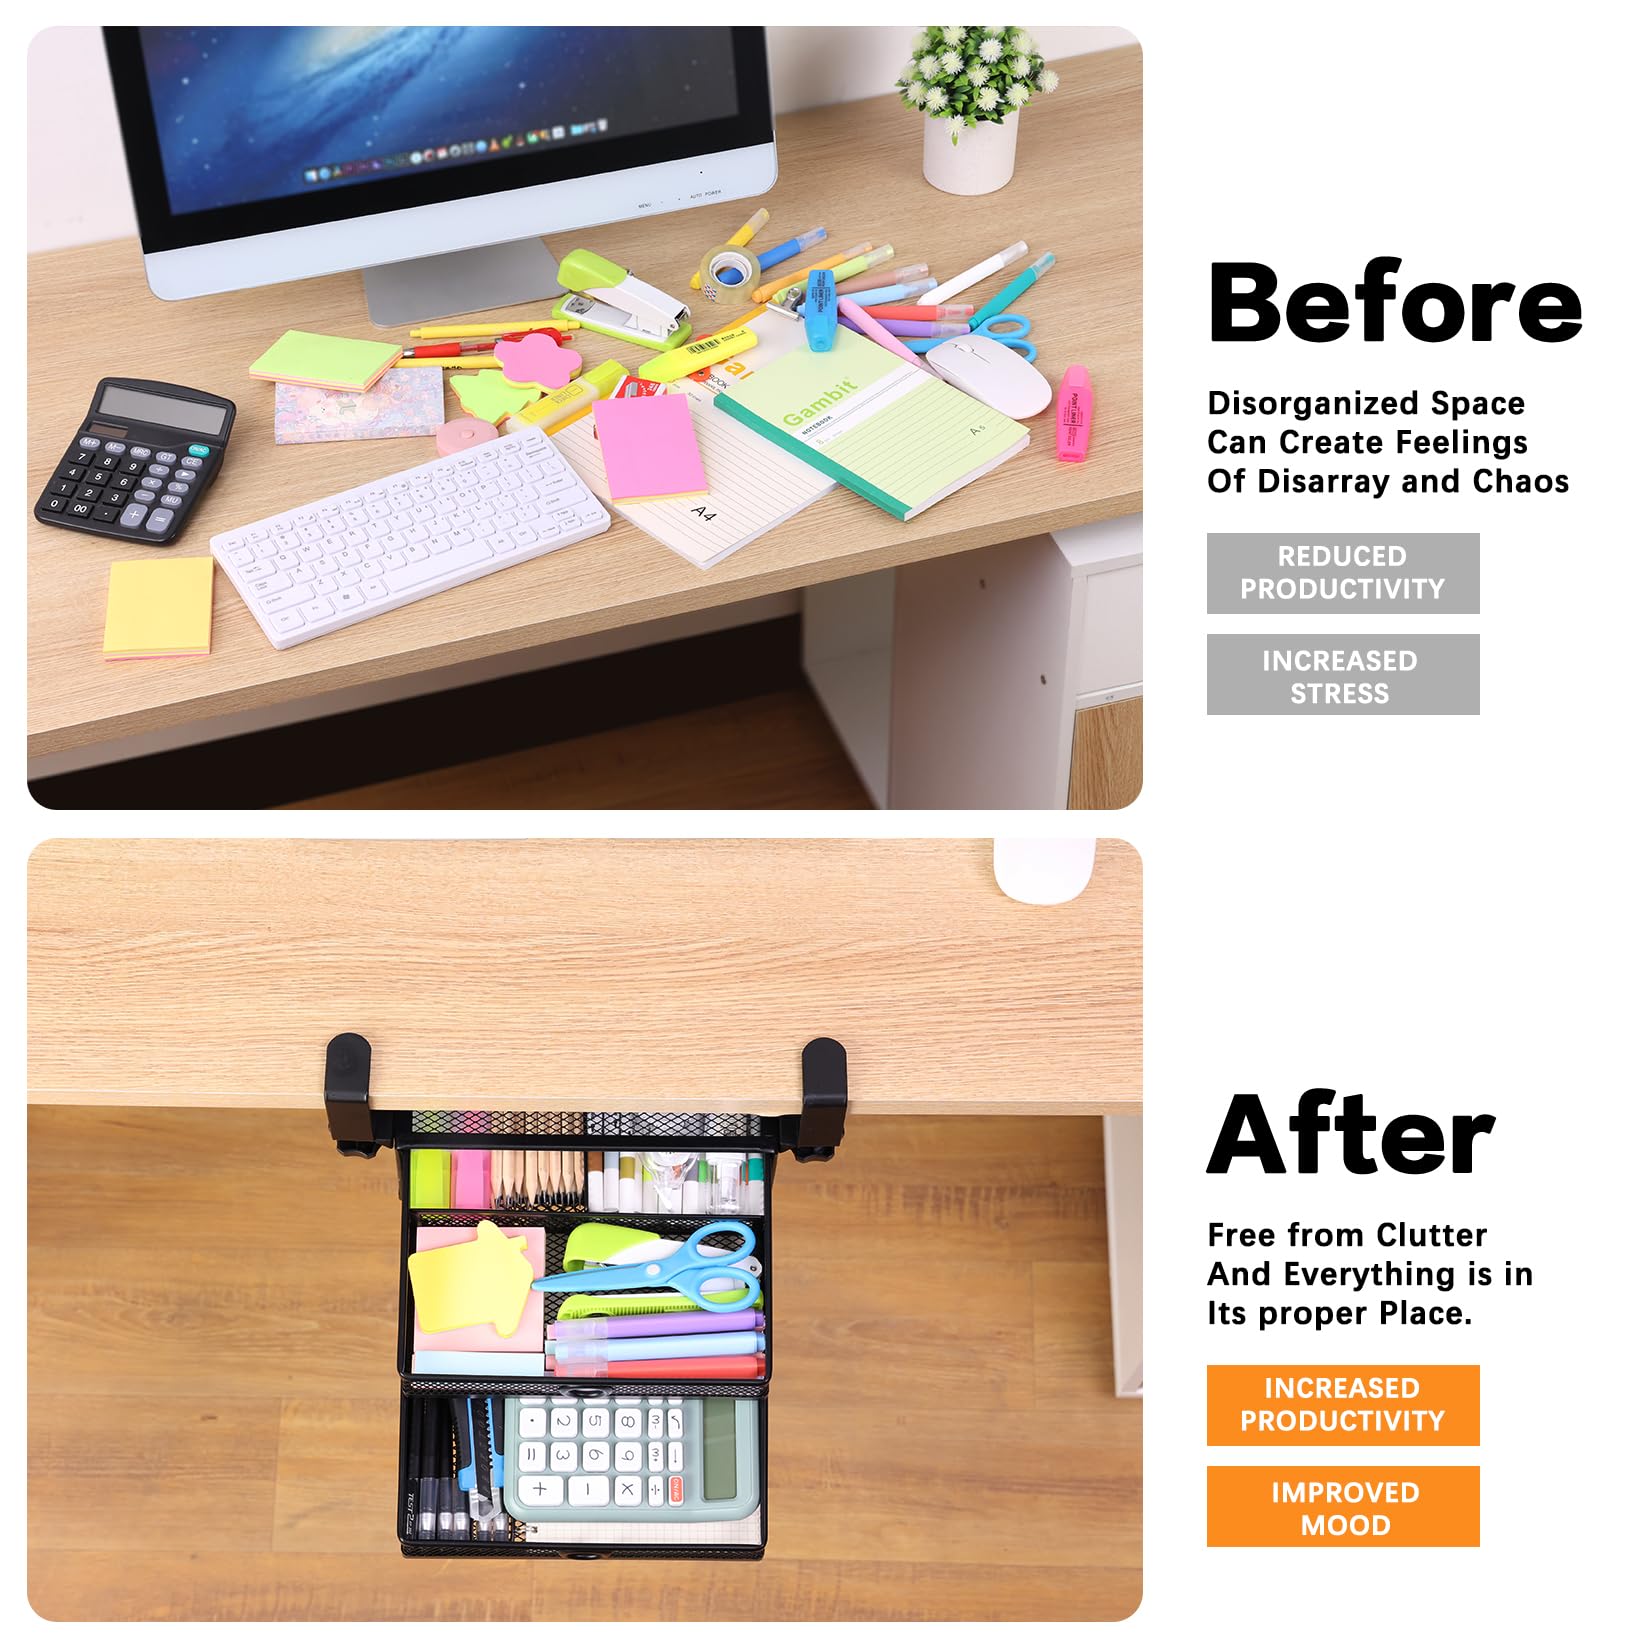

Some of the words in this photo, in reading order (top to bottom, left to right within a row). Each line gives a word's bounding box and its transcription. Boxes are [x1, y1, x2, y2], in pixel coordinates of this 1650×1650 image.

[704, 189, 722, 197] POWER
[783, 380, 859, 427] Gambit
[801, 415, 834, 436] NOTEBOOK
[120, 478, 128, 486] 6
[84, 489, 93, 497] 2
[111, 494, 119, 502] 3
[74, 504, 87, 513] 00
[690, 506, 718, 521] A4
[556, 1415, 571, 1426] 2
[588, 1414, 602, 1427] 5
[621, 1415, 635, 1428] 8
[556, 1449, 570, 1461] 3
[588, 1448, 604, 1461] 6
[621, 1450, 635, 1461] 9
